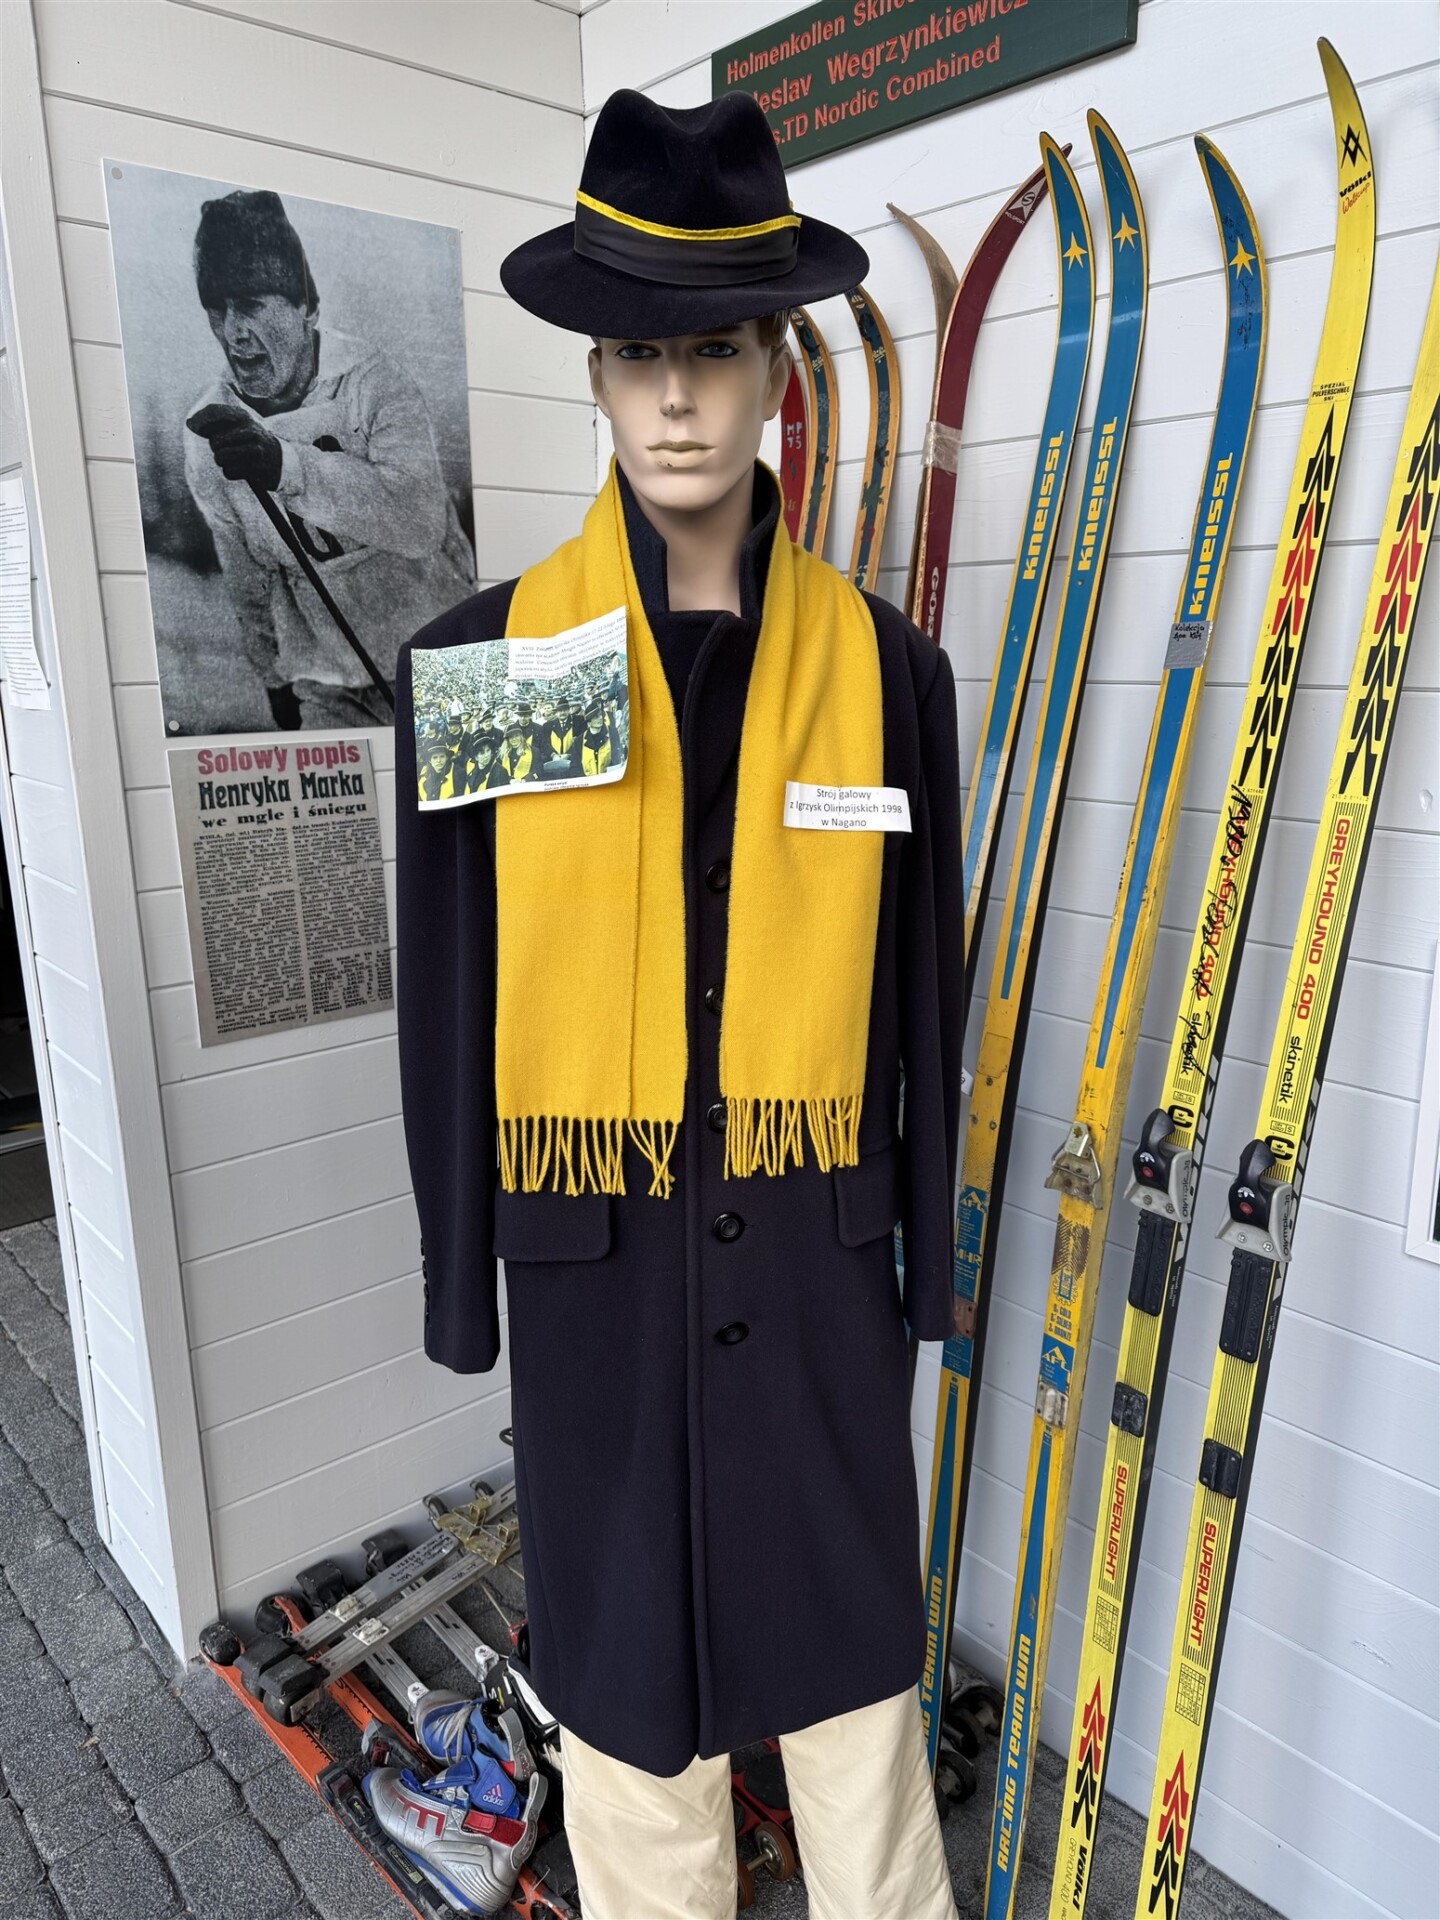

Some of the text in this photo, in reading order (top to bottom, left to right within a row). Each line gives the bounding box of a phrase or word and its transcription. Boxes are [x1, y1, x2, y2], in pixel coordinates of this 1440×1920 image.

[727, 18, 846, 84] Holmenkollen
[814, 88, 879, 131] Nordic
[886, 34, 1001, 102] Combined
[1320, 381, 1346, 390] SPEZIAL
[198, 740, 361, 775] Solowy popis
[198, 770, 365, 811] Henryka Marka
[795, 800, 822, 812] Igrzysk
[823, 803, 879, 815] Olimpijskich
[881, 804, 903, 814] 1998
[816, 788, 872, 801] Strój galowy
[201, 802, 367, 828] we mgle i śniegu
[821, 818, 867, 829] w Nagano
[1309, 818, 1351, 965] GREYHOUND
[1296, 973, 1317, 1021] 400
[1279, 1036, 1302, 1103] skinetik
[1105, 1464, 1128, 1580] SUPERLIGHT
[1190, 1520, 1217, 1646] SUPERLIGHT
[1063, 1837, 1078, 1885] GREYHOUND
[1061, 1884, 1072, 1904] 400
